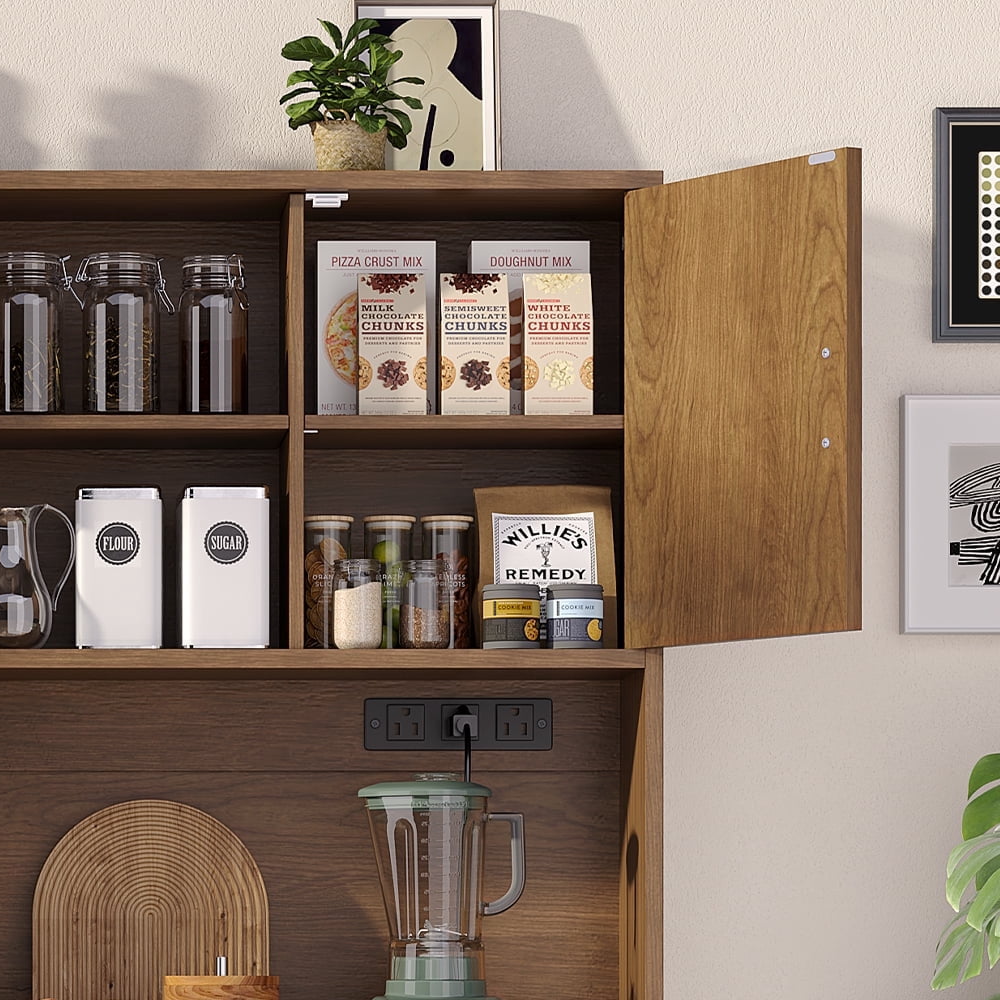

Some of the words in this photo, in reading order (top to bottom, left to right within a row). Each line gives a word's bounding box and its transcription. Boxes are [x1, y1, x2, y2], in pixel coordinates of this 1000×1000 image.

[331, 256, 361, 267] PIZZA
[364, 256, 399, 267] CRUST
[403, 256, 422, 267] MIX
[490, 256, 548, 267] DOUGHNUT
[552, 256, 572, 267] MIX
[361, 304, 394, 312] MILK
[527, 304, 571, 312] WHITE
[361, 321, 424, 331] CHUNKS
[444, 321, 507, 331] CHUNKS
[527, 321, 590, 331] CHUNKS
[321, 403, 333, 411] NET
[502, 523, 588, 550] WILLIE'S
[102, 536, 134, 551] FLOUR
[211, 535, 243, 550] SUGAR
[506, 568, 586, 580] REMEDY
